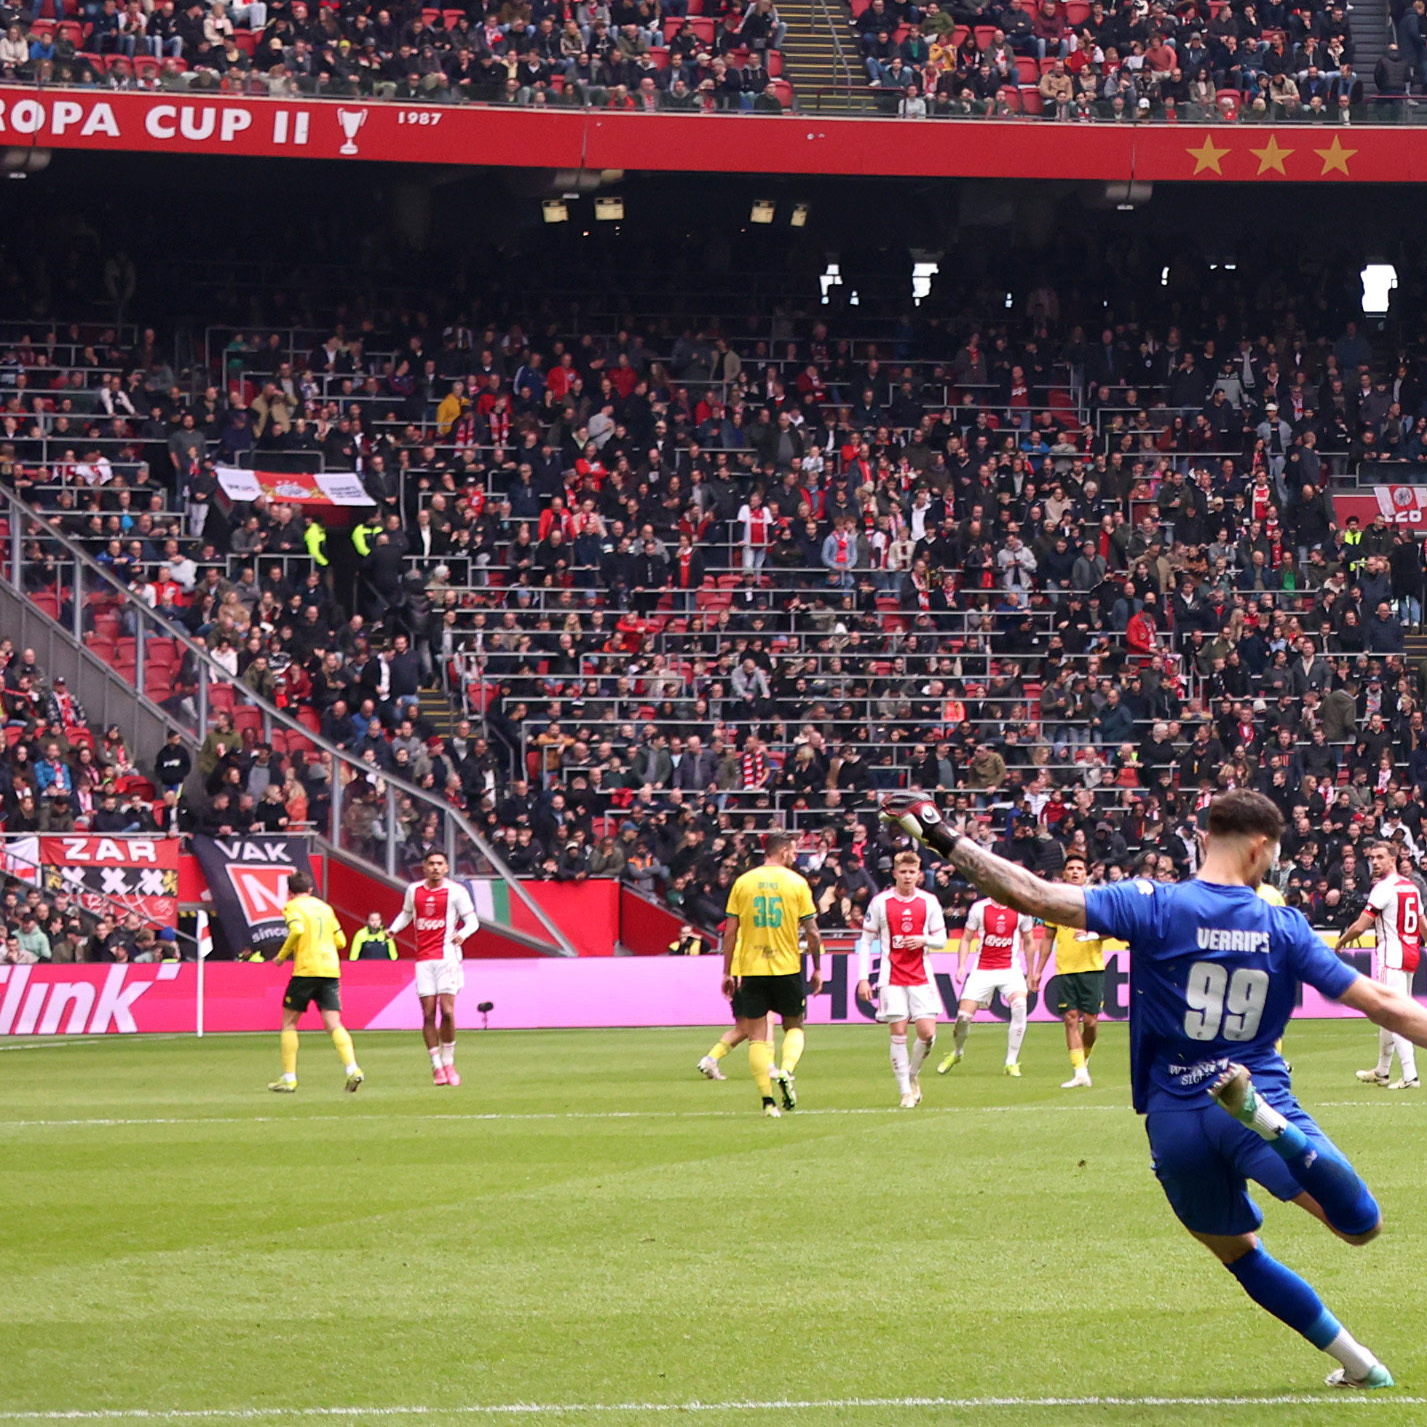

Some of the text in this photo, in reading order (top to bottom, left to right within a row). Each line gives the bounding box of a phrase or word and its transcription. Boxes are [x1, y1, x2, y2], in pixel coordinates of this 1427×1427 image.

[145, 105, 253, 142] CUP
[273, 111, 310, 145] II
[398, 112, 443, 126] 1987
[62, 838, 156, 861] ZAR
[214, 839, 292, 862] VAK
[753, 896, 784, 928] 35
[1404, 897, 1419, 934] 6
[0, 963, 154, 1035] link
[1184, 961, 1269, 1041] 99
